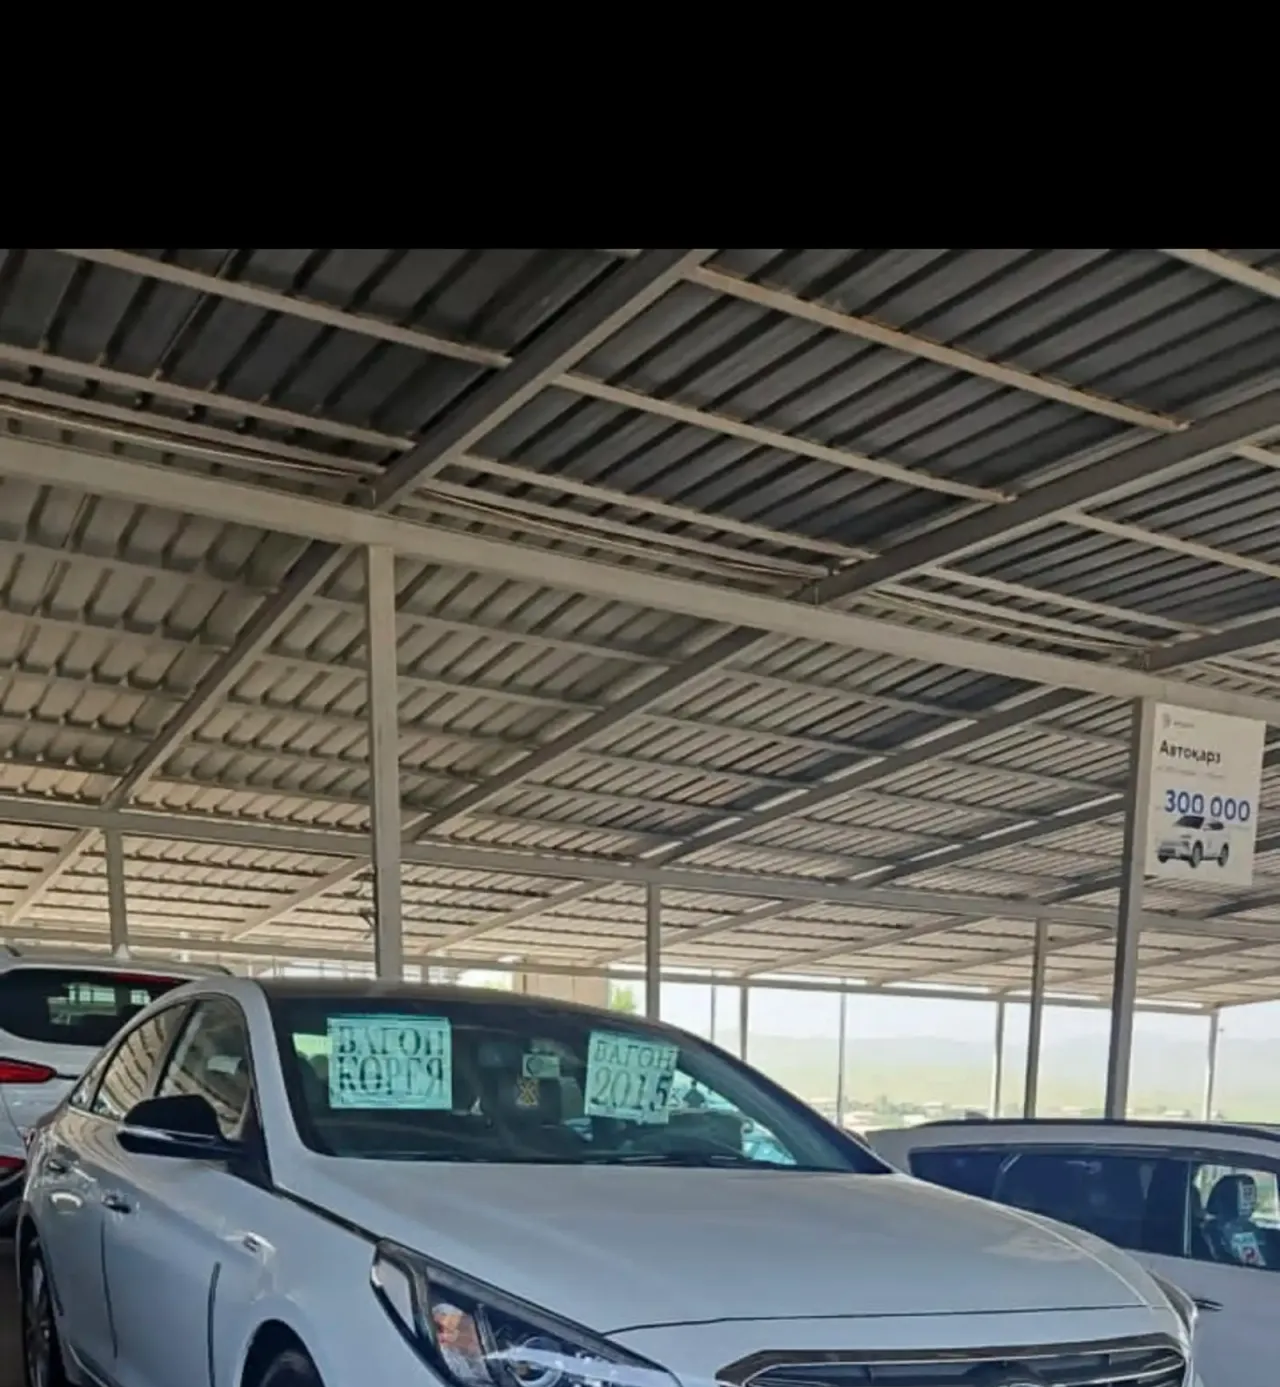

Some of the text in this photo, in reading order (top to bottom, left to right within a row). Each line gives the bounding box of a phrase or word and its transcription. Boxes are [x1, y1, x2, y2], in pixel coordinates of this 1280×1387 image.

[1164, 789, 1251, 822] 300 000
[594, 1039, 676, 1071] ВАГОН
[591, 1066, 674, 1112] 2015
